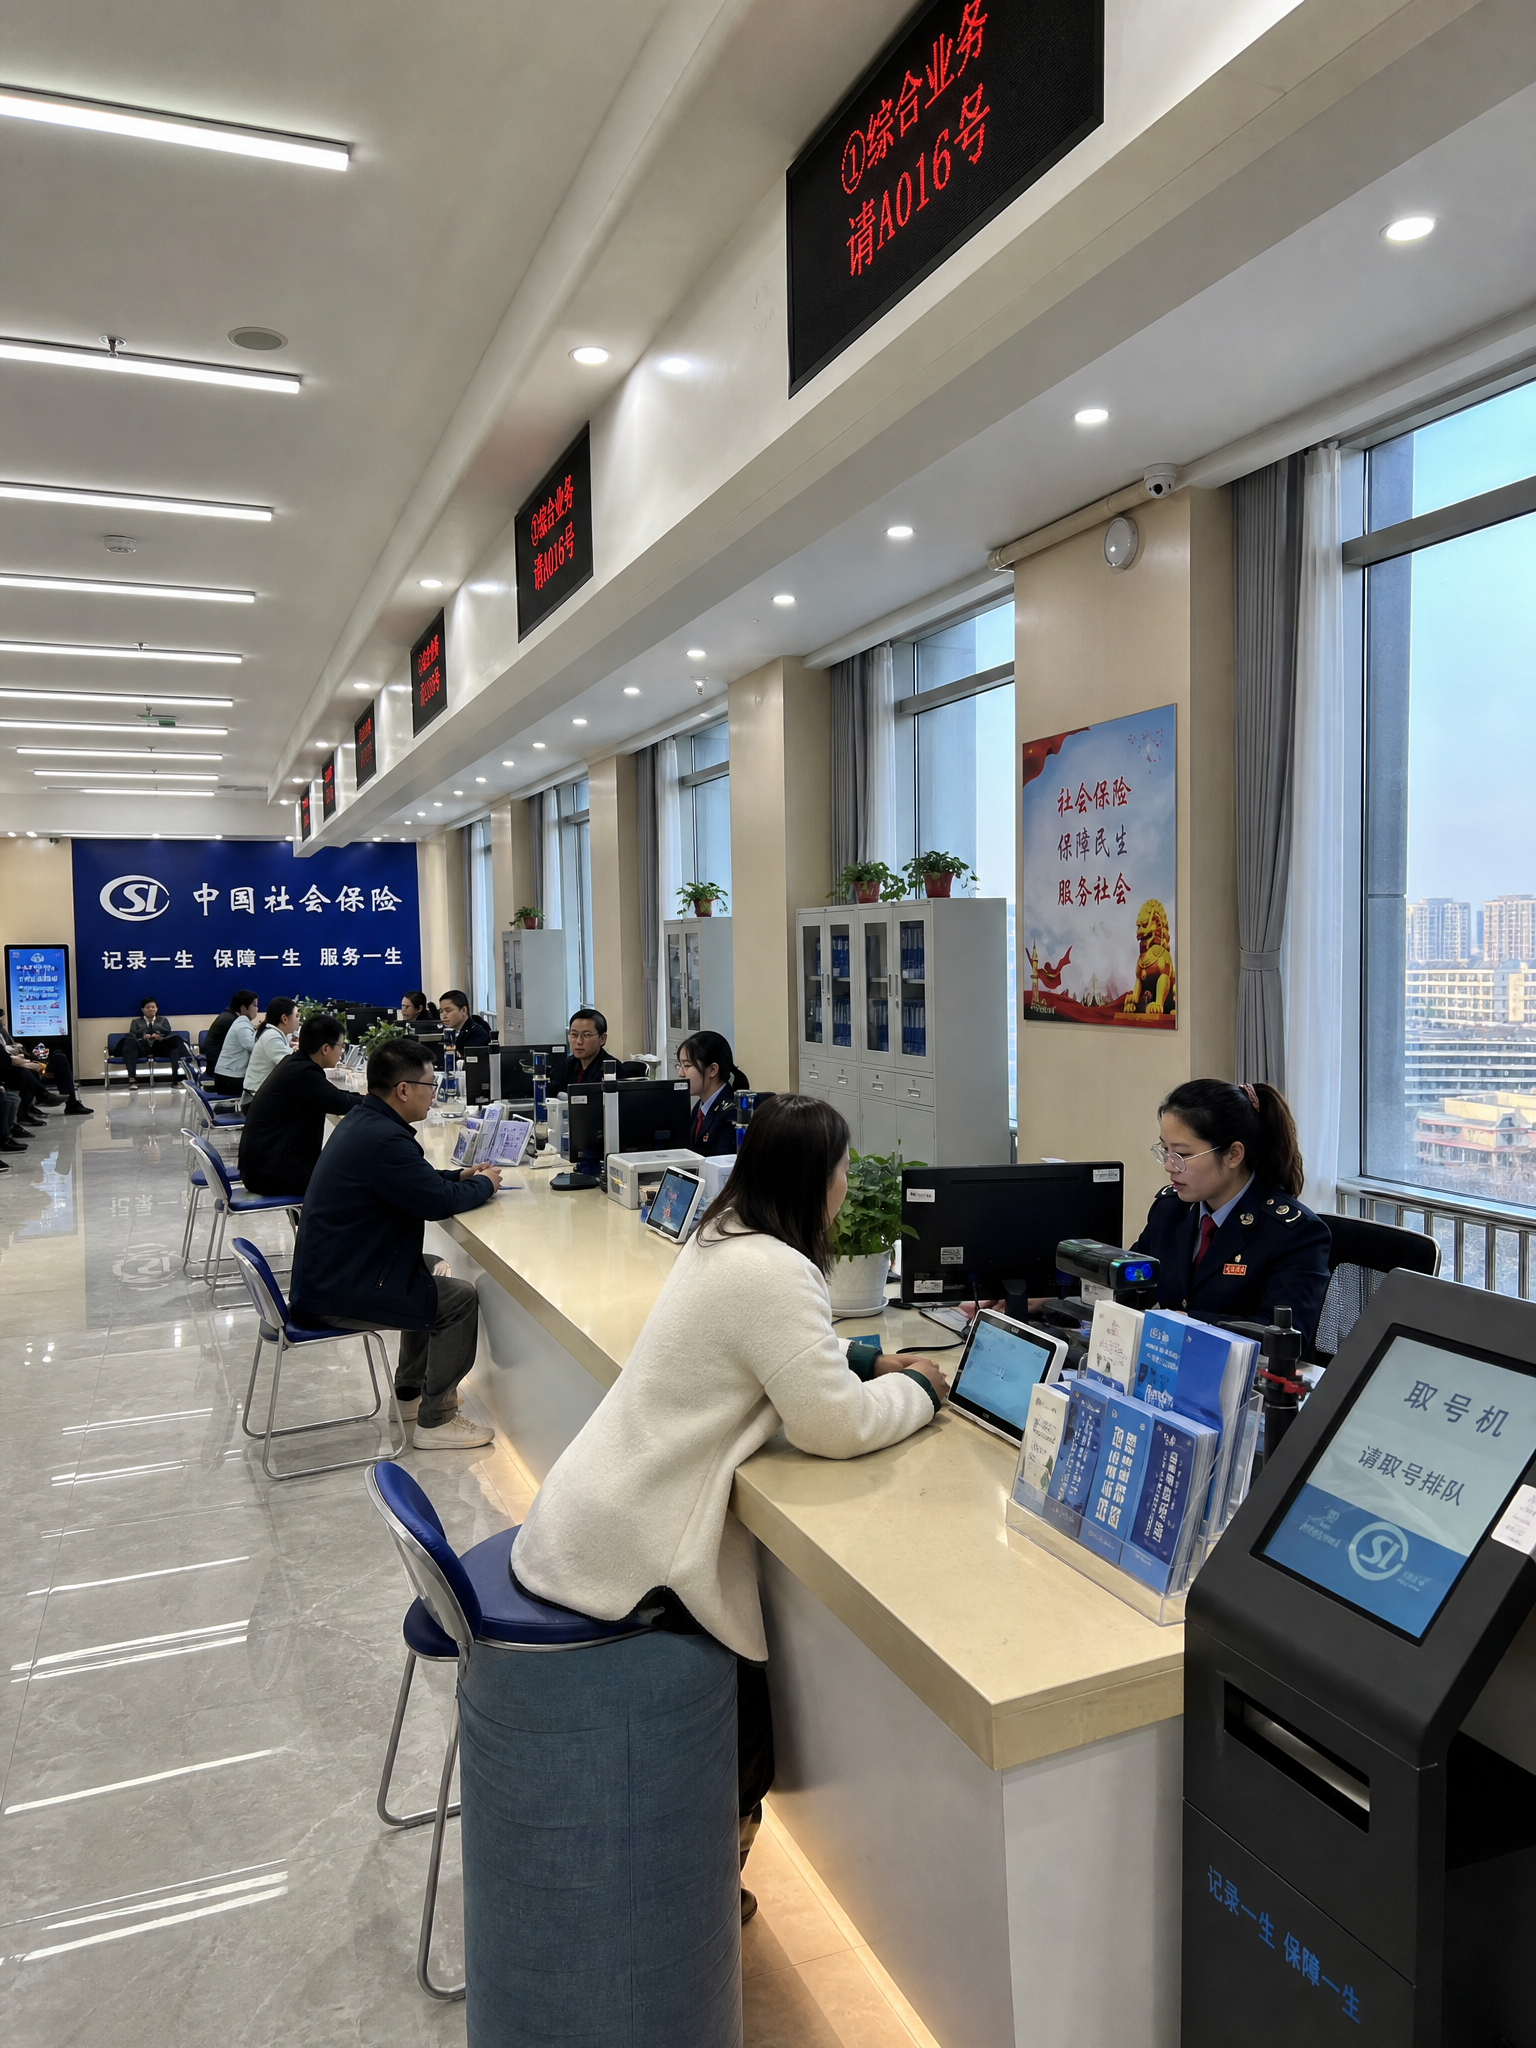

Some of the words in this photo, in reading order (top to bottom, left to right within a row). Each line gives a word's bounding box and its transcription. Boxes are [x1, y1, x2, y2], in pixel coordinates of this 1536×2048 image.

[846, 84, 990, 276] 请A016号
[1056, 776, 1132, 818] 社会保险
[1057, 824, 1127, 862] 保障民生
[192, 882, 403, 917] 中国社会保险
[1057, 872, 1131, 907] 服务社会
[101, 950, 195, 970] 记录一生
[213, 948, 302, 969] 保障一生
[320, 946, 403, 967] 服务一生
[1403, 1379, 1510, 1438] 取号机
[1357, 1445, 1466, 1507] 请取号排队
[1207, 1864, 1276, 1950] 记录一生
[1283, 1931, 1361, 2025] 保障一生
